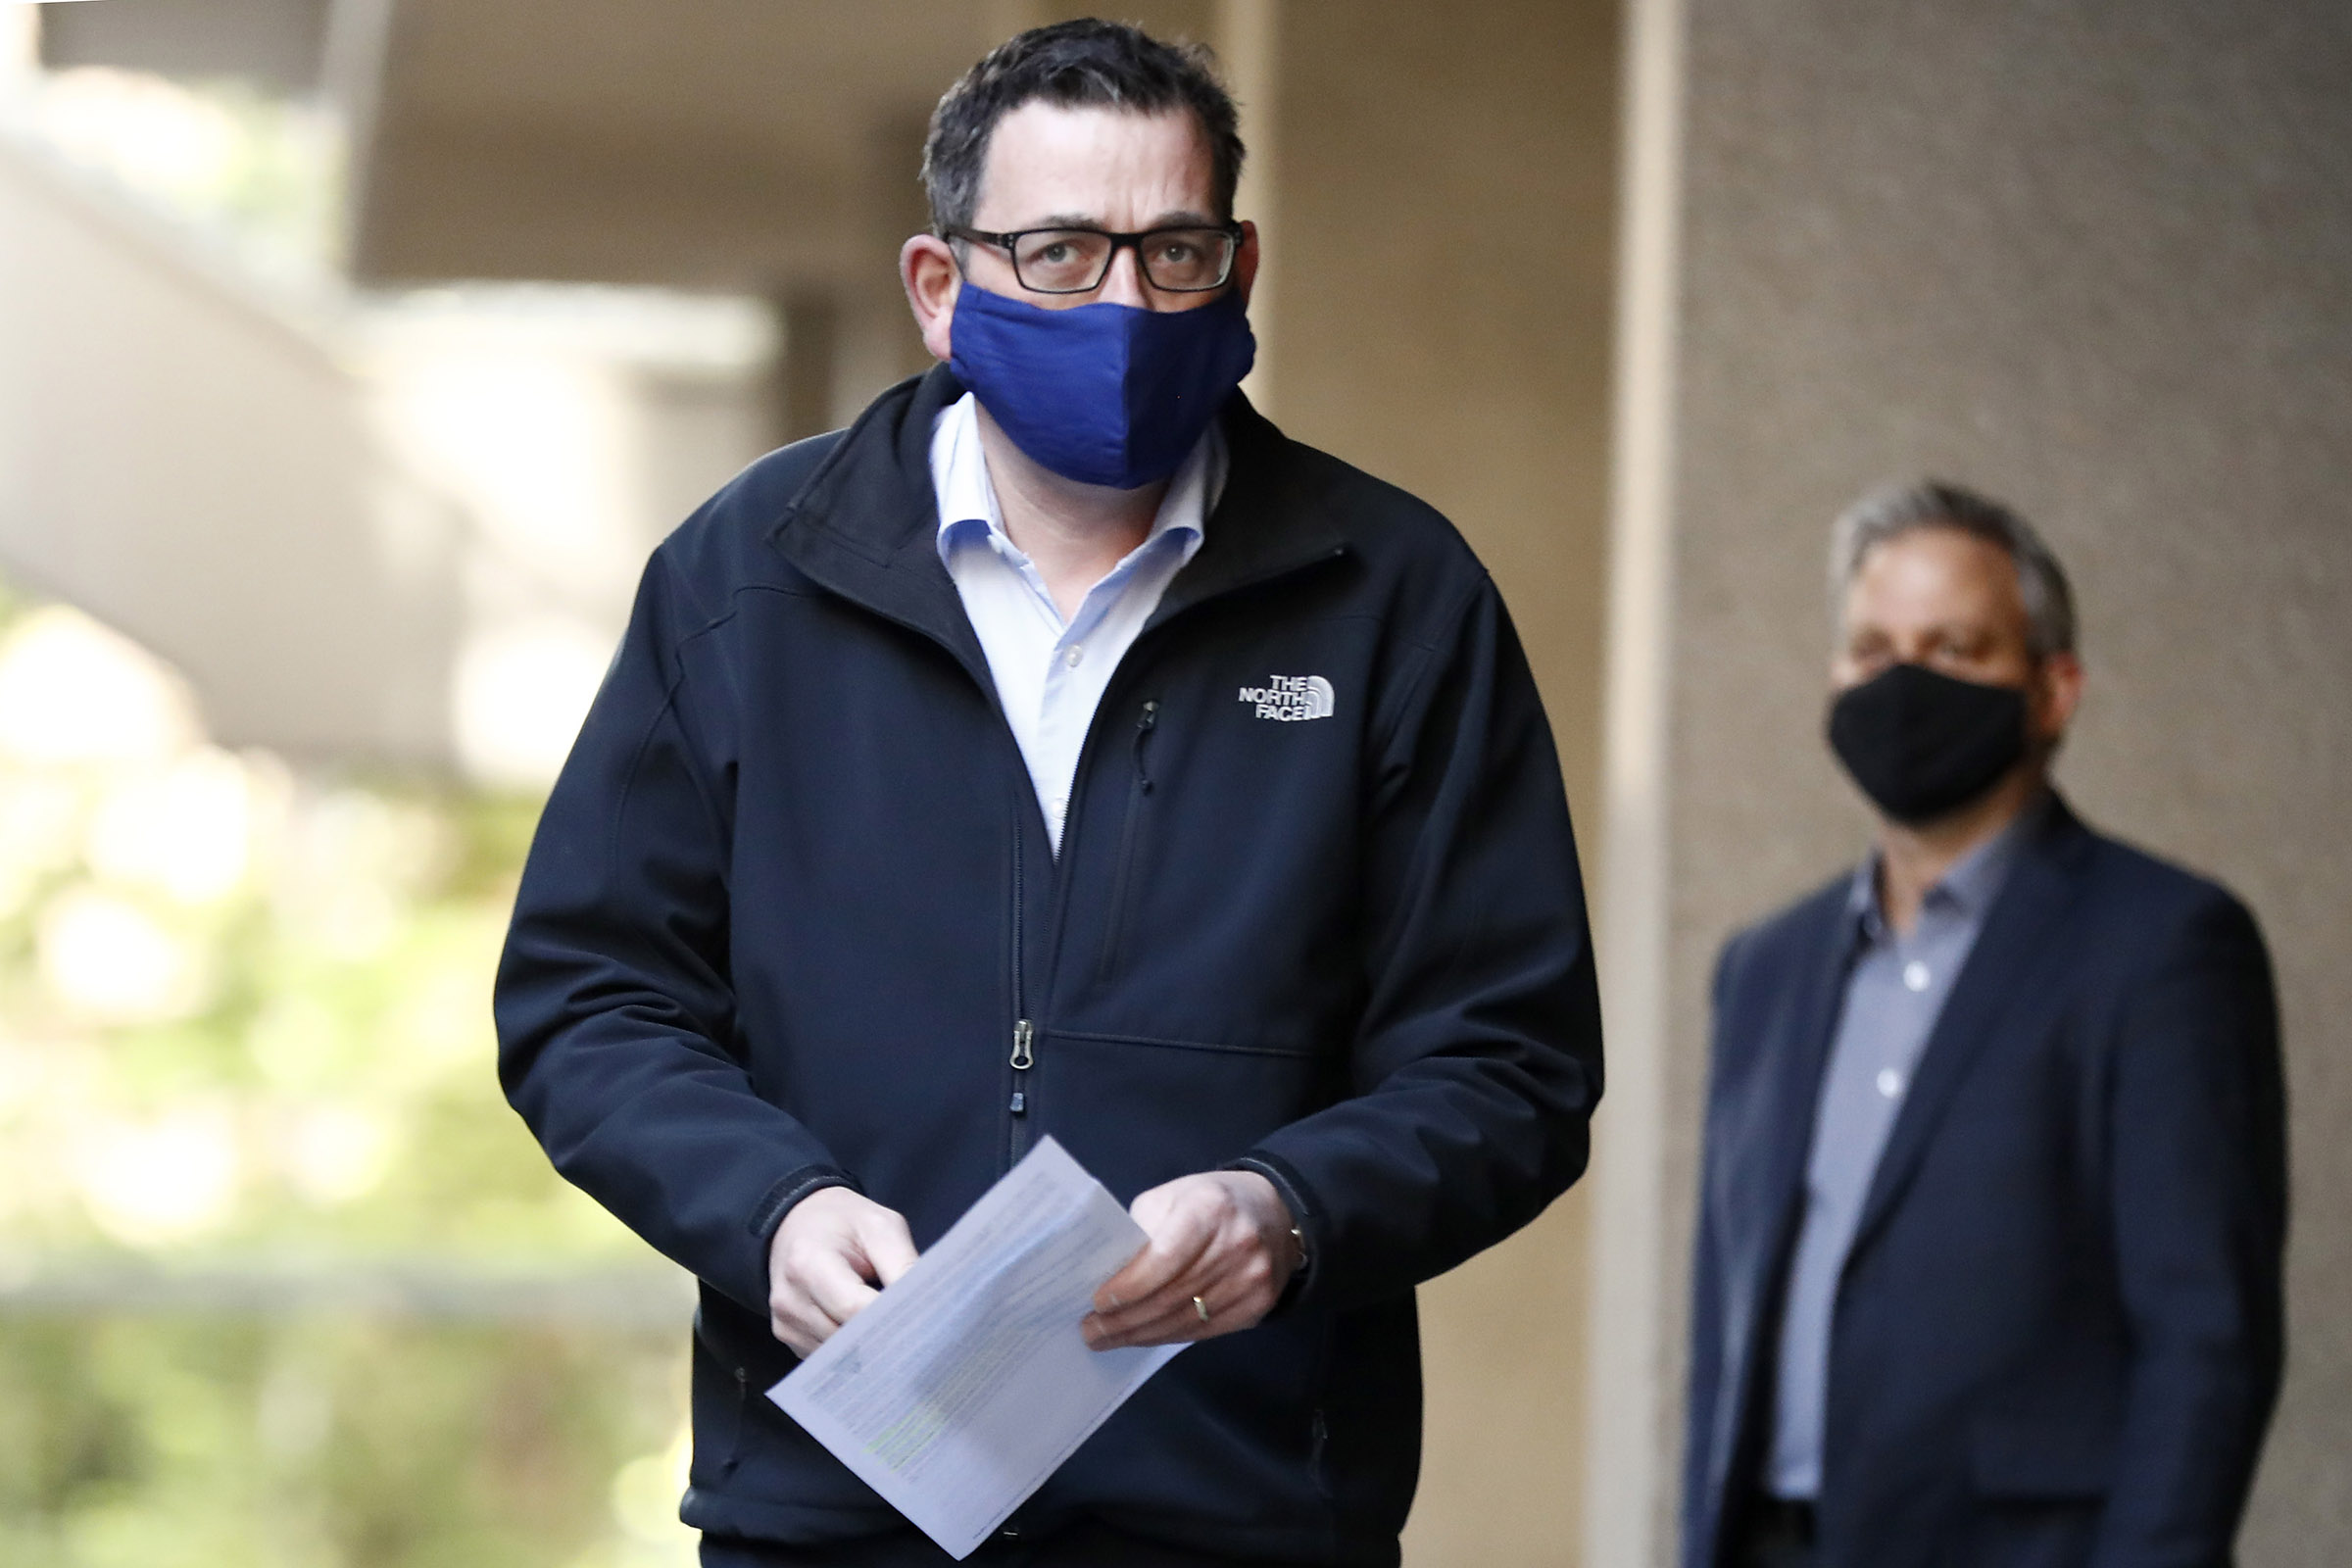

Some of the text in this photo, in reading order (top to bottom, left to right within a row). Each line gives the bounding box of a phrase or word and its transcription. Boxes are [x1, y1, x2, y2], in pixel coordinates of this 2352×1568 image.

[1270, 675, 1307, 691] THE
[1239, 687, 1306, 706] NORTH
[1255, 704, 1305, 721] FACE
